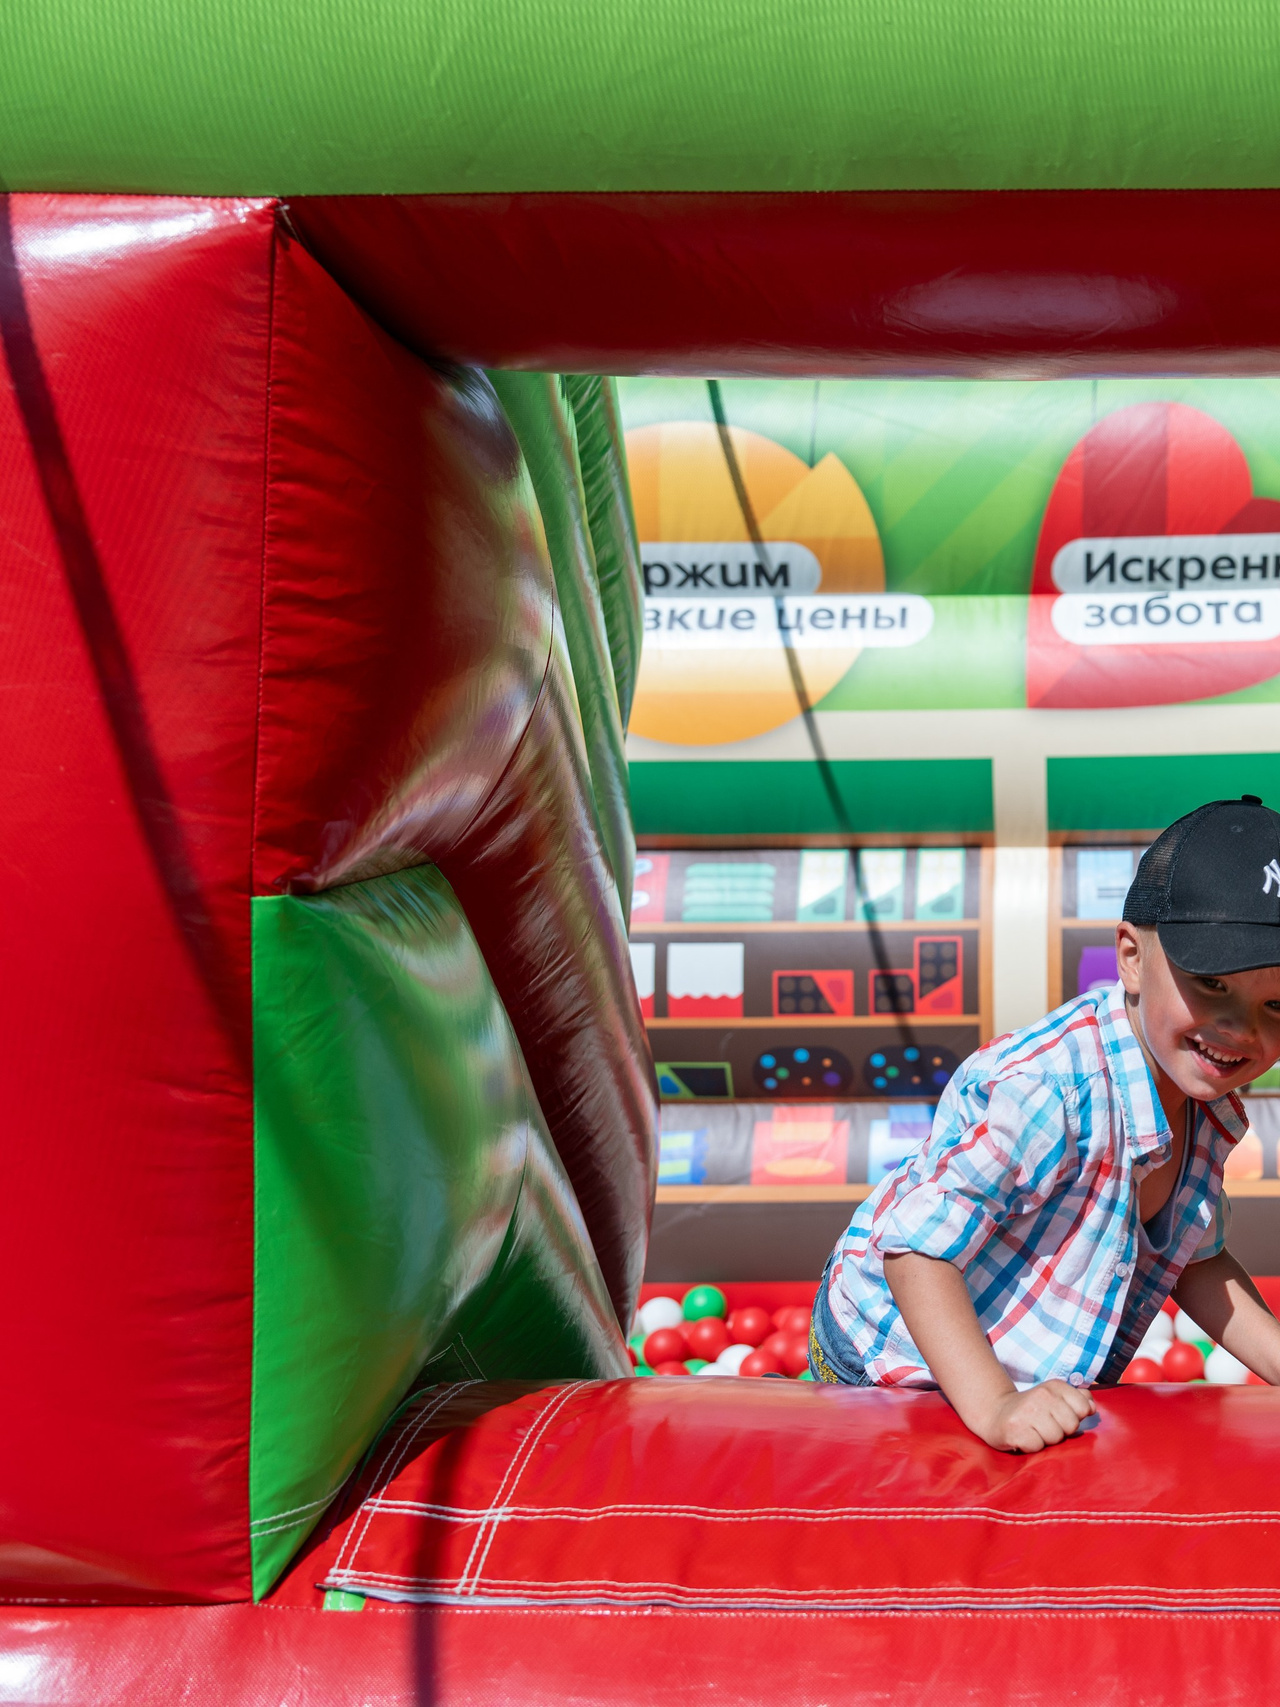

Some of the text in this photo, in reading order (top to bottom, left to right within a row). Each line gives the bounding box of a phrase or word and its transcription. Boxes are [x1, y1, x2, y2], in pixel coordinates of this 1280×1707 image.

[642, 562, 790, 595] ржим
[643, 606, 908, 635] зкие цены
[1084, 593, 1263, 628] забота
